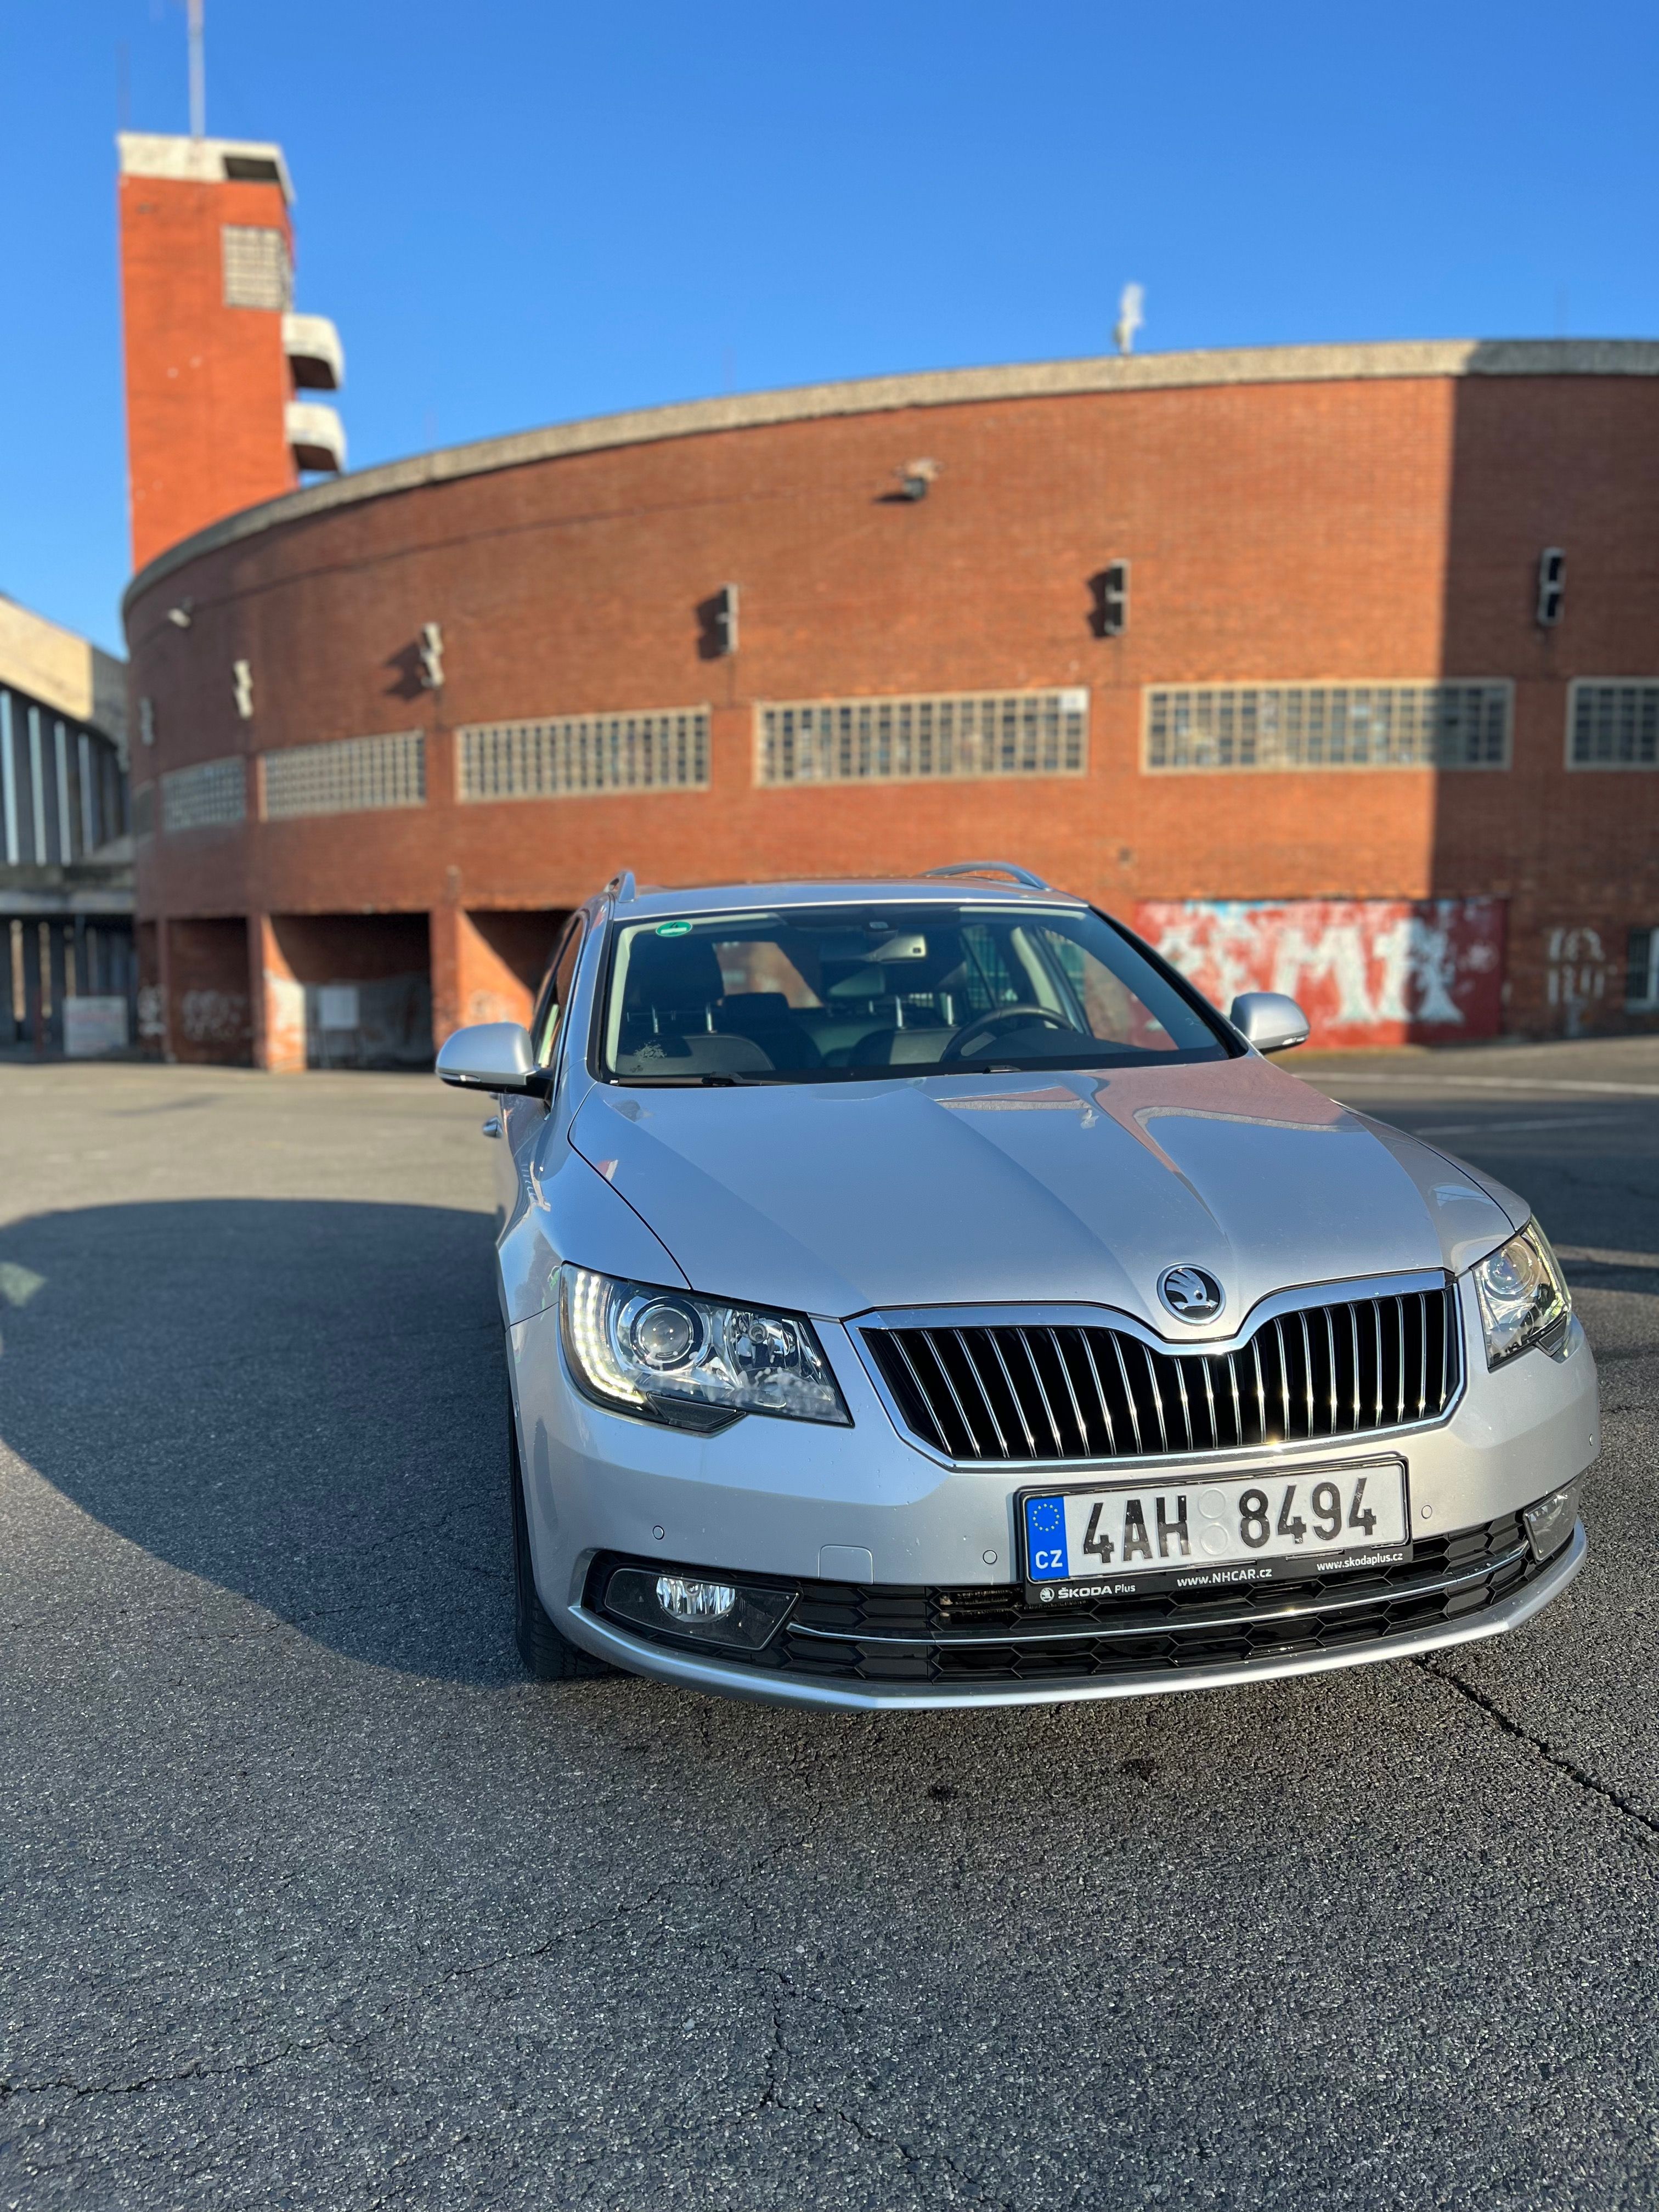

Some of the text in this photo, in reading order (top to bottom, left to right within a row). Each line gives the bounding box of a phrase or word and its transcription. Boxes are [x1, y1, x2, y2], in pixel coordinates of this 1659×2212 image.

[1083, 1477, 1376, 1564] 4AH 8494
[1035, 1549, 1063, 1569] CZ
[1316, 1552, 1403, 1571] www.skodaplus.cz
[1177, 1568, 1272, 1587] www.NHCAR.cz
[1058, 1583, 1136, 1599] ŠKODA Plus
